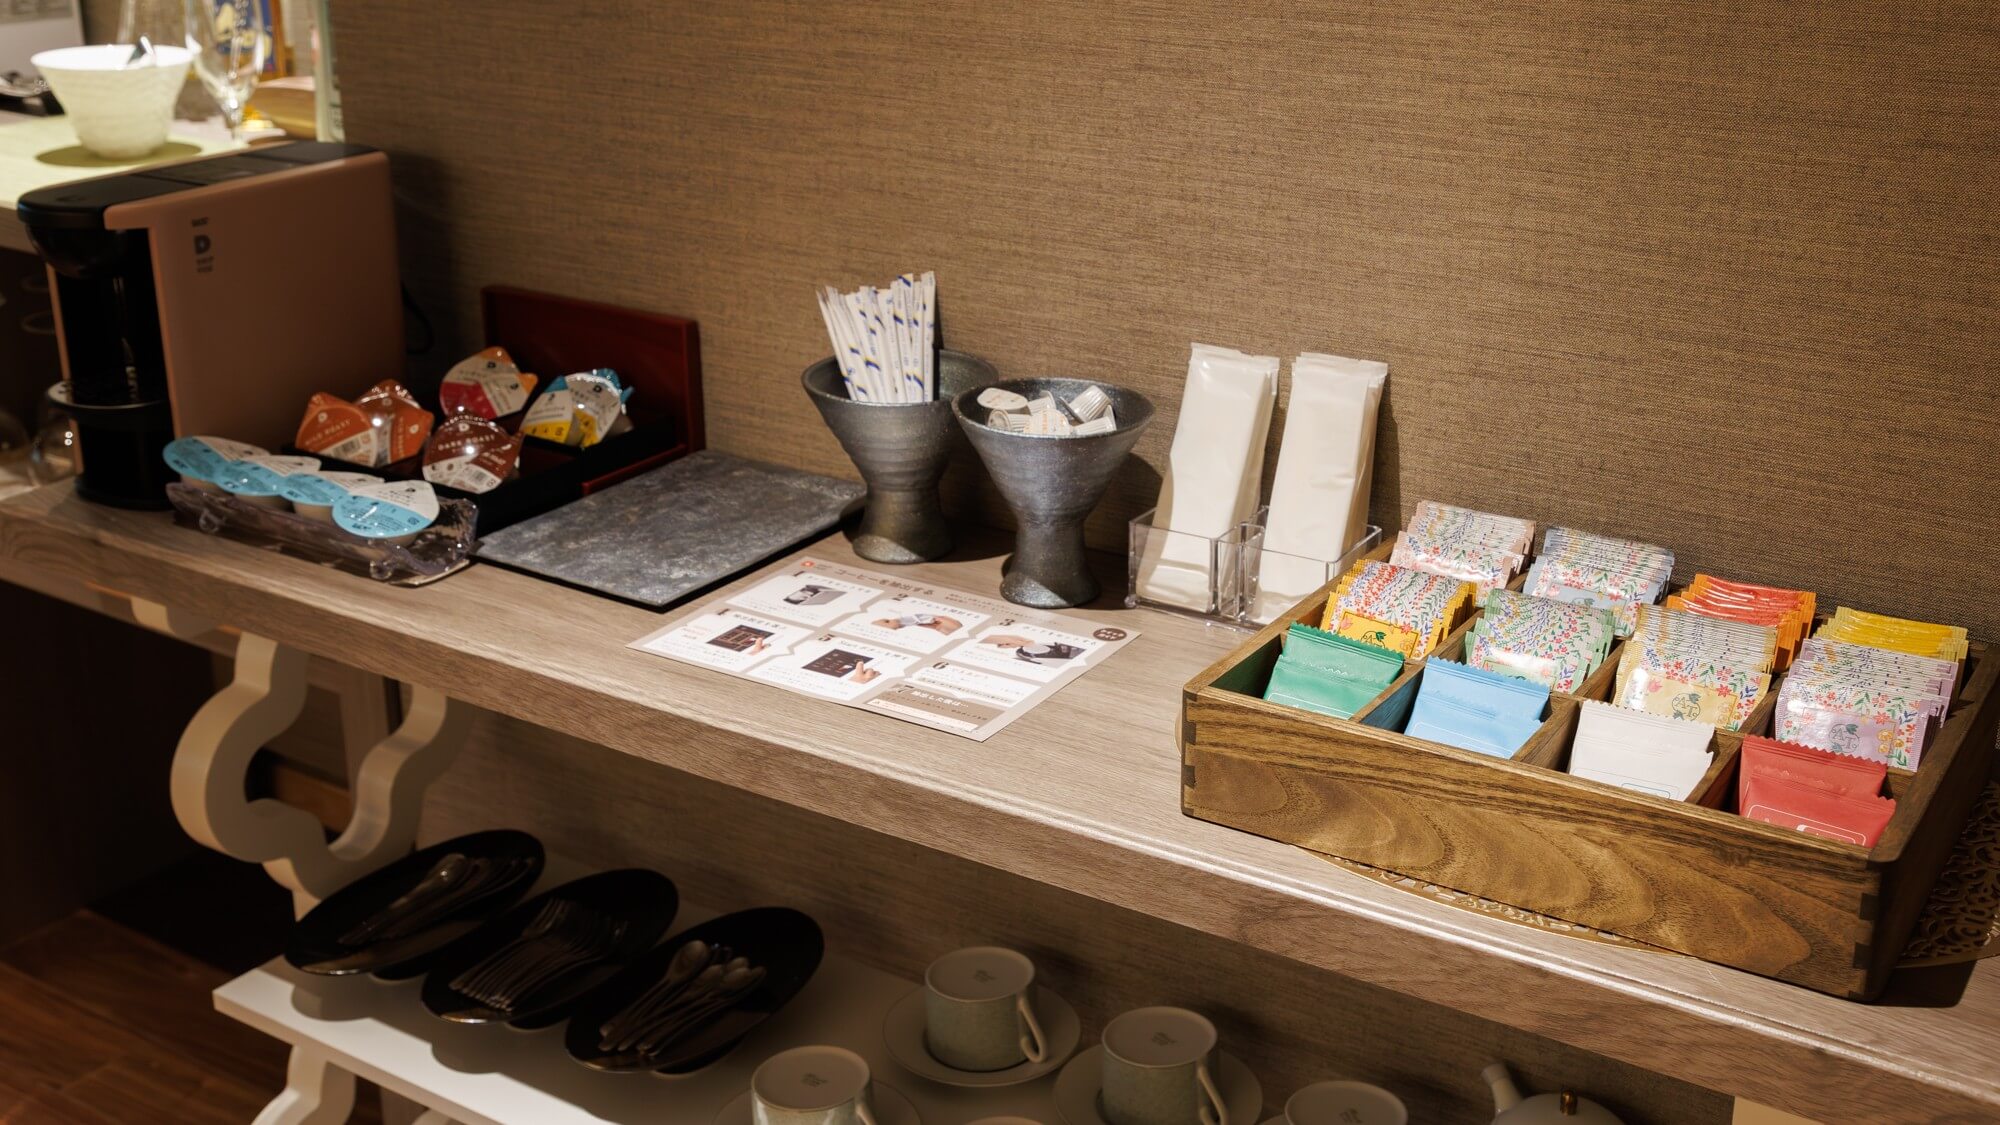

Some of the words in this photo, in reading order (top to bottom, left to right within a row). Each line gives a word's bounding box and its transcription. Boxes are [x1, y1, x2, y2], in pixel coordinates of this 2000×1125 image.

[437, 440, 462, 451] DARK
[465, 434, 496, 444] ROAST
[892, 593, 909, 601] 2
[999, 618, 1016, 626] 3
[818, 633, 835, 641] 5
[932, 661, 949, 669] 6
[896, 684, 914, 694] 7
